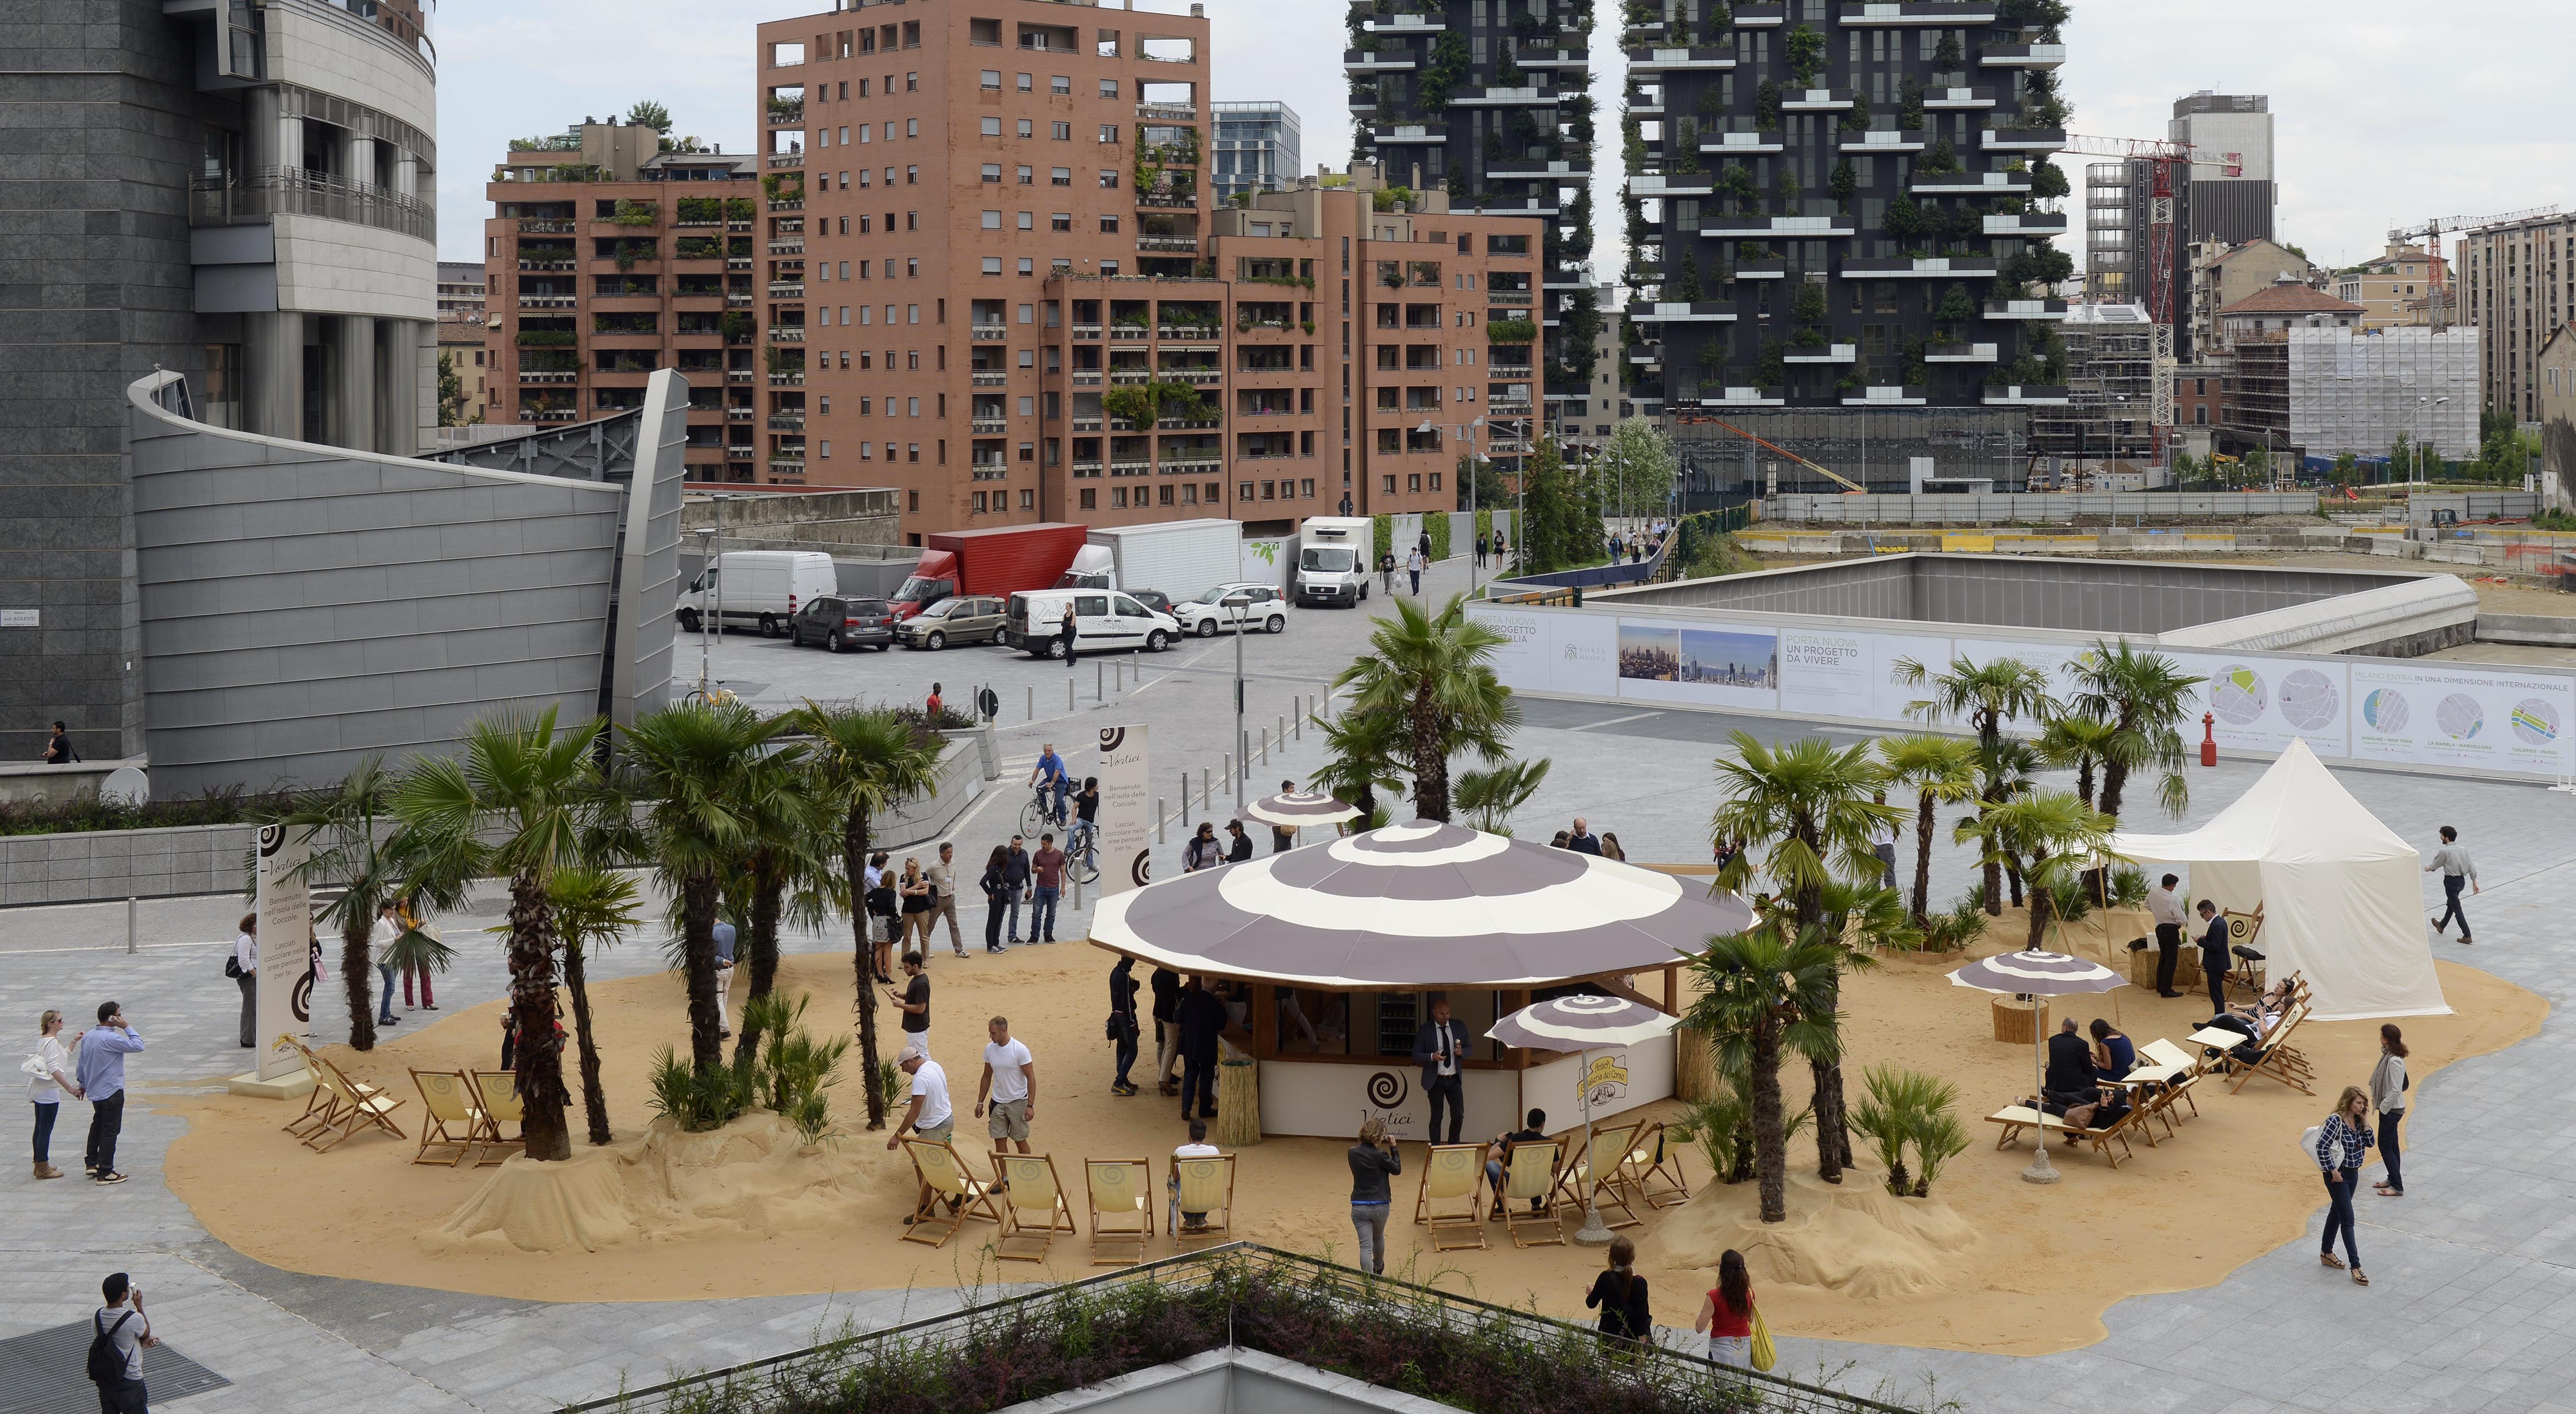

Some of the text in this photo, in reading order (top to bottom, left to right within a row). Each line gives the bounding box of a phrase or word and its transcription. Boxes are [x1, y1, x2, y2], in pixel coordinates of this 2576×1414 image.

[1506, 617, 1536, 626] NUOVA
[1490, 625, 1536, 635] PROGETTO
[1787, 635, 1858, 647] PORTA NUOVA
[1787, 645, 1858, 657] UN PROGETTO
[1787, 654, 1839, 665] DA VIVERE
[2444, 678, 2494, 686] DIMENSIONE
[2496, 681, 2569, 691] INTERNAZIONALE
[1108, 753, 1141, 768] Vortici
[268, 855, 302, 876] Vortici
[270, 893, 302, 905] Benvenuto
[264, 902, 306, 917] nell'isola delle
[272, 914, 298, 925] Coccole.
[275, 939, 296, 950] Lasciati
[264, 946, 306, 962] coccolare nelle
[281, 957, 303, 969] pensate
[274, 972, 284, 980] per
[1611, 1070, 1625, 1080] Corso
